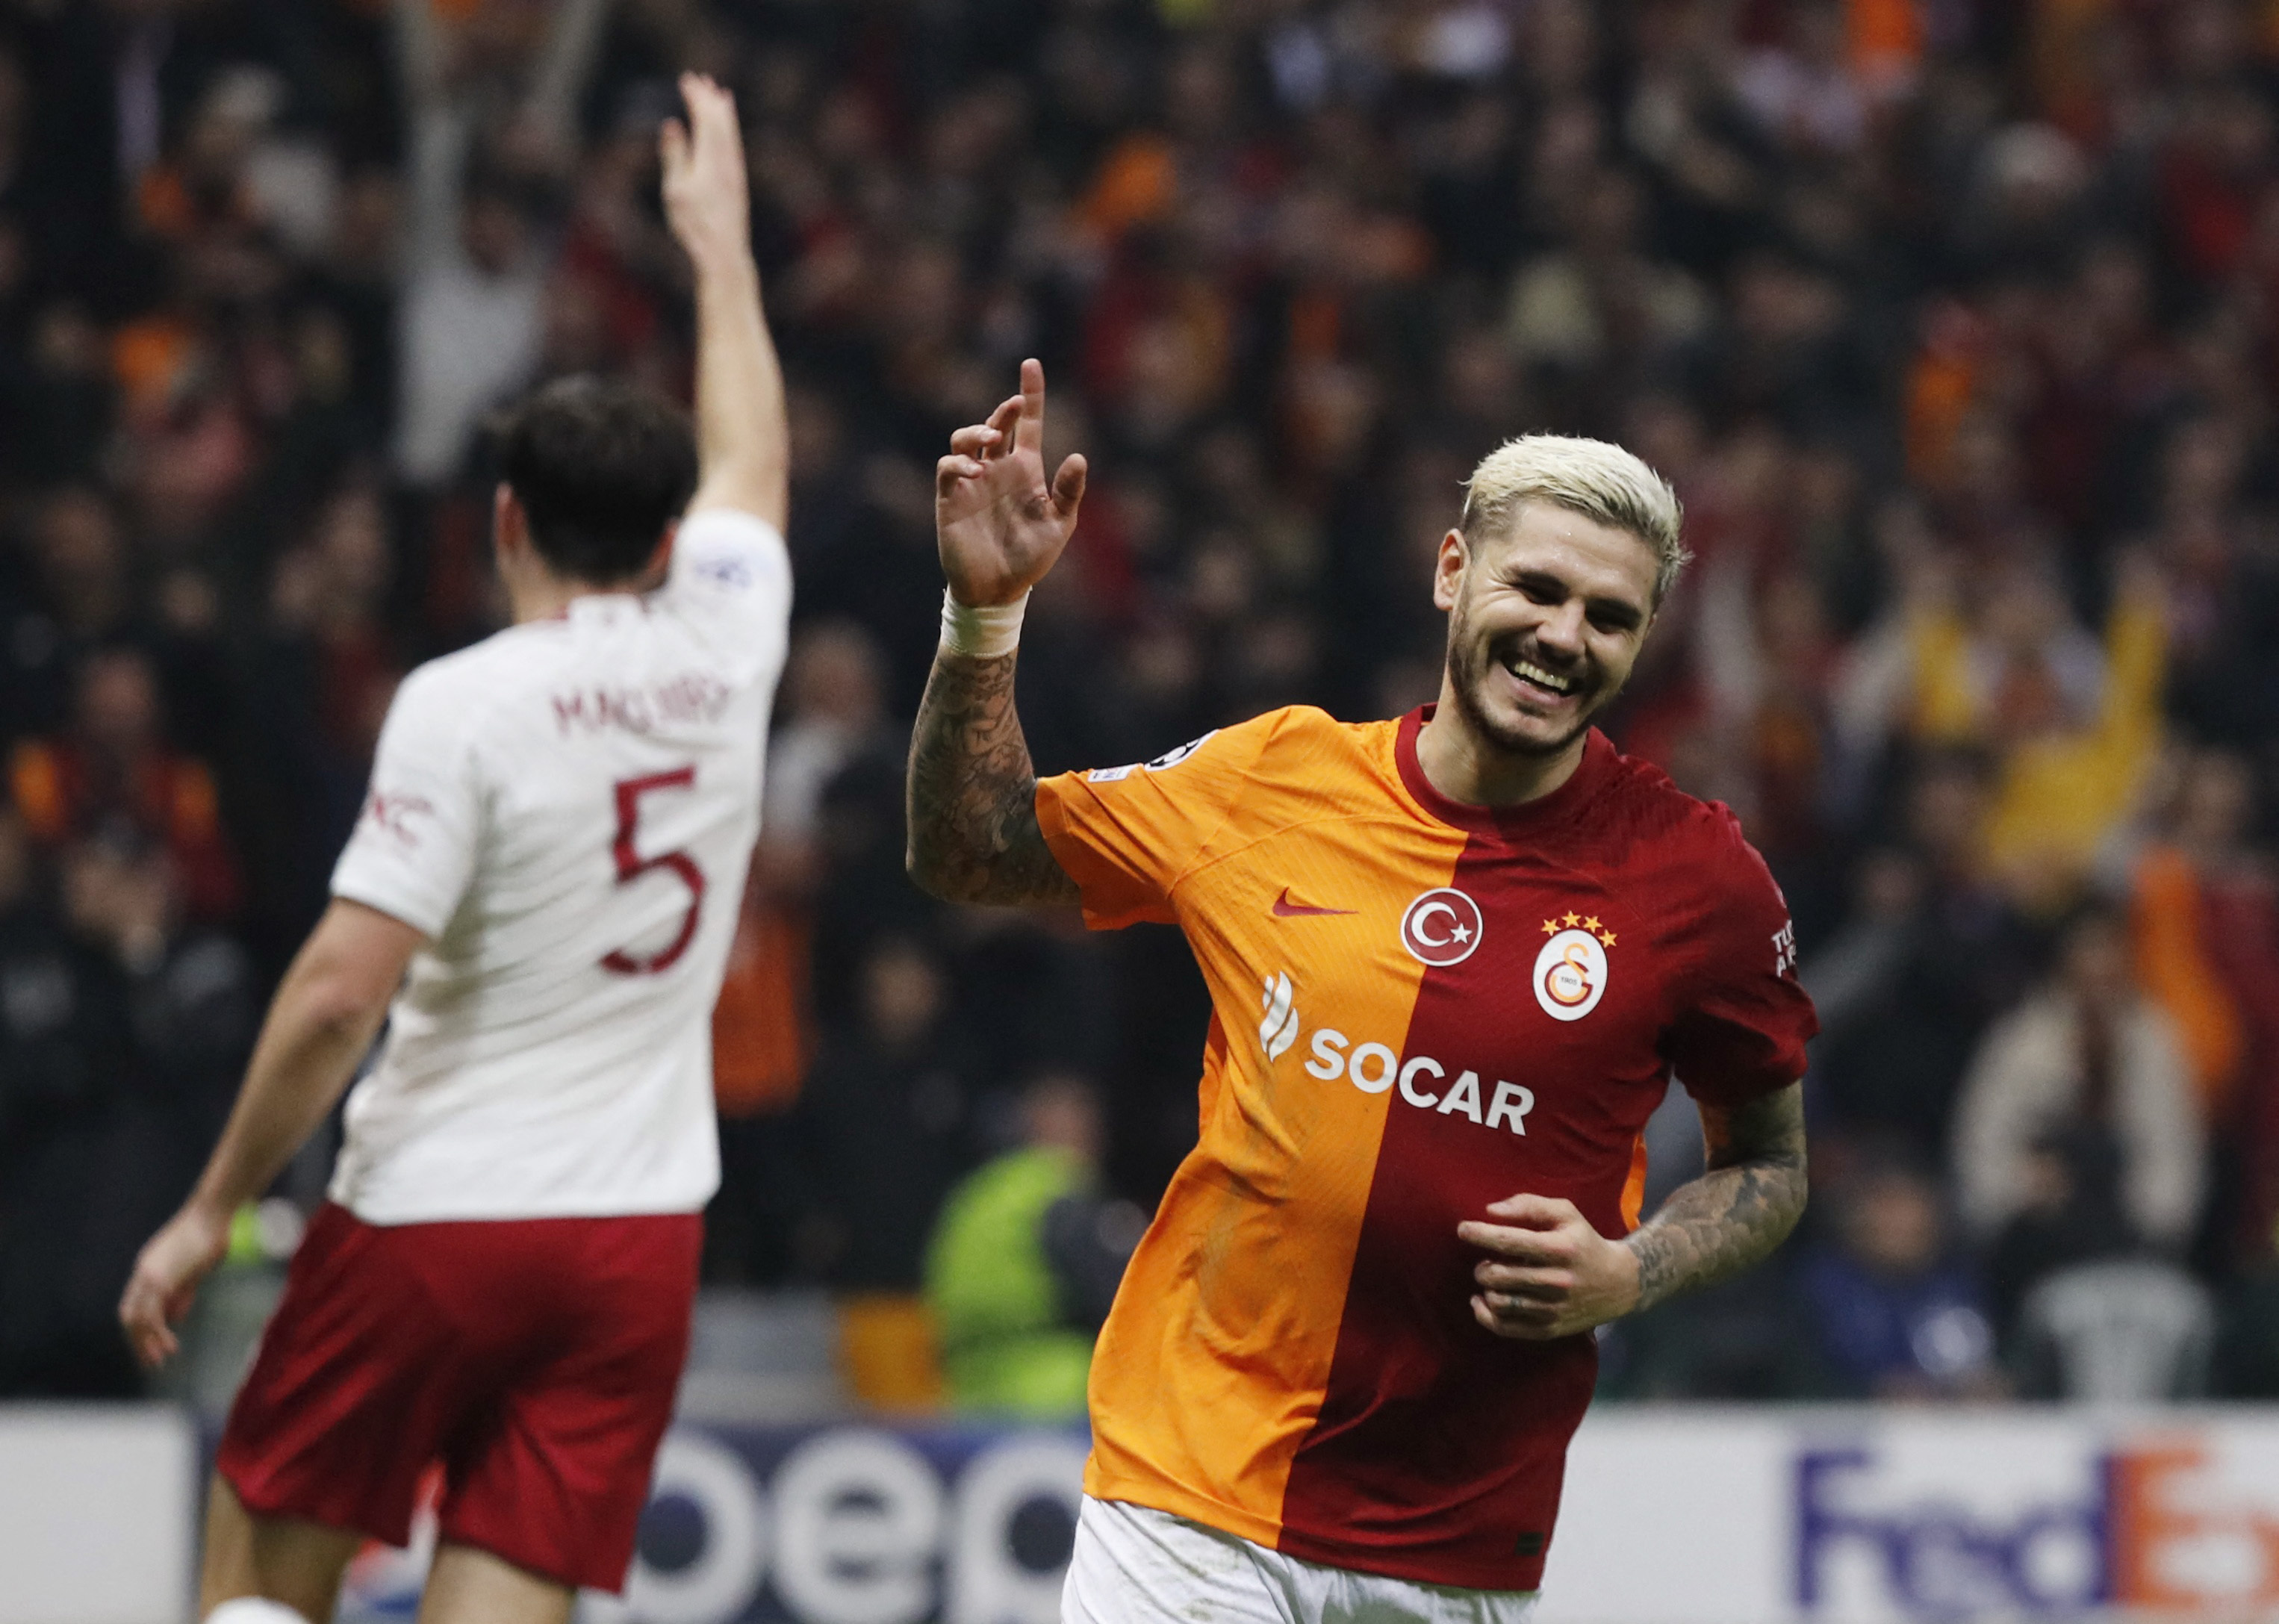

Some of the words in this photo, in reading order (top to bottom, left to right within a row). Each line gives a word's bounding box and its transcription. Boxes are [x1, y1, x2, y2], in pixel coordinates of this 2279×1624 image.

[599, 762, 707, 975] 5
[1304, 1027, 1535, 1136] SOCAR
[1792, 1445, 2279, 1619] FedE
